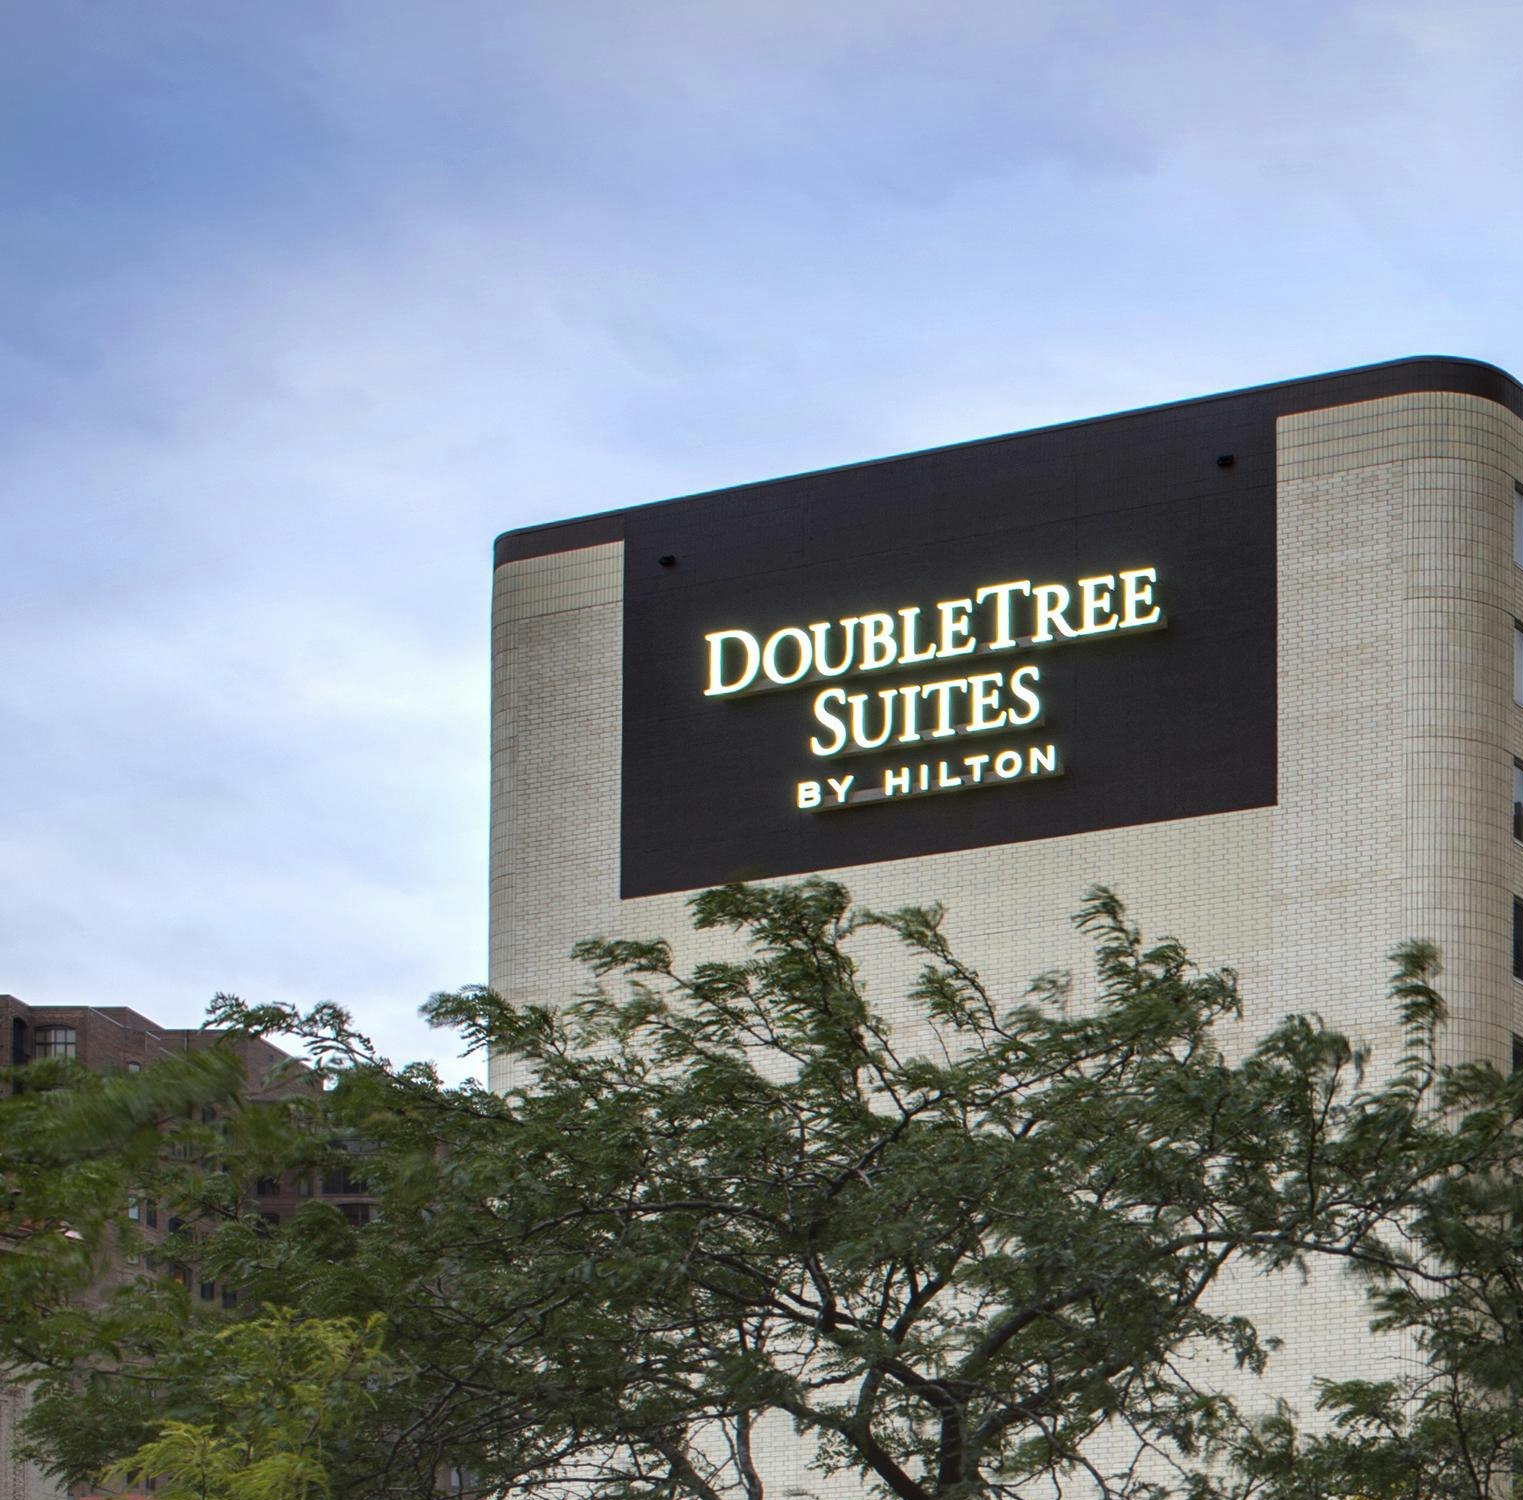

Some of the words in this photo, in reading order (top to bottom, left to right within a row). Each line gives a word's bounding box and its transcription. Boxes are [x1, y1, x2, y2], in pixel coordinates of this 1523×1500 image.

[703, 566, 1163, 697] DOUBLETREE
[809, 665, 1042, 757] SUITES
[796, 773, 857, 810] BY
[884, 744, 1058, 797] HILTON
